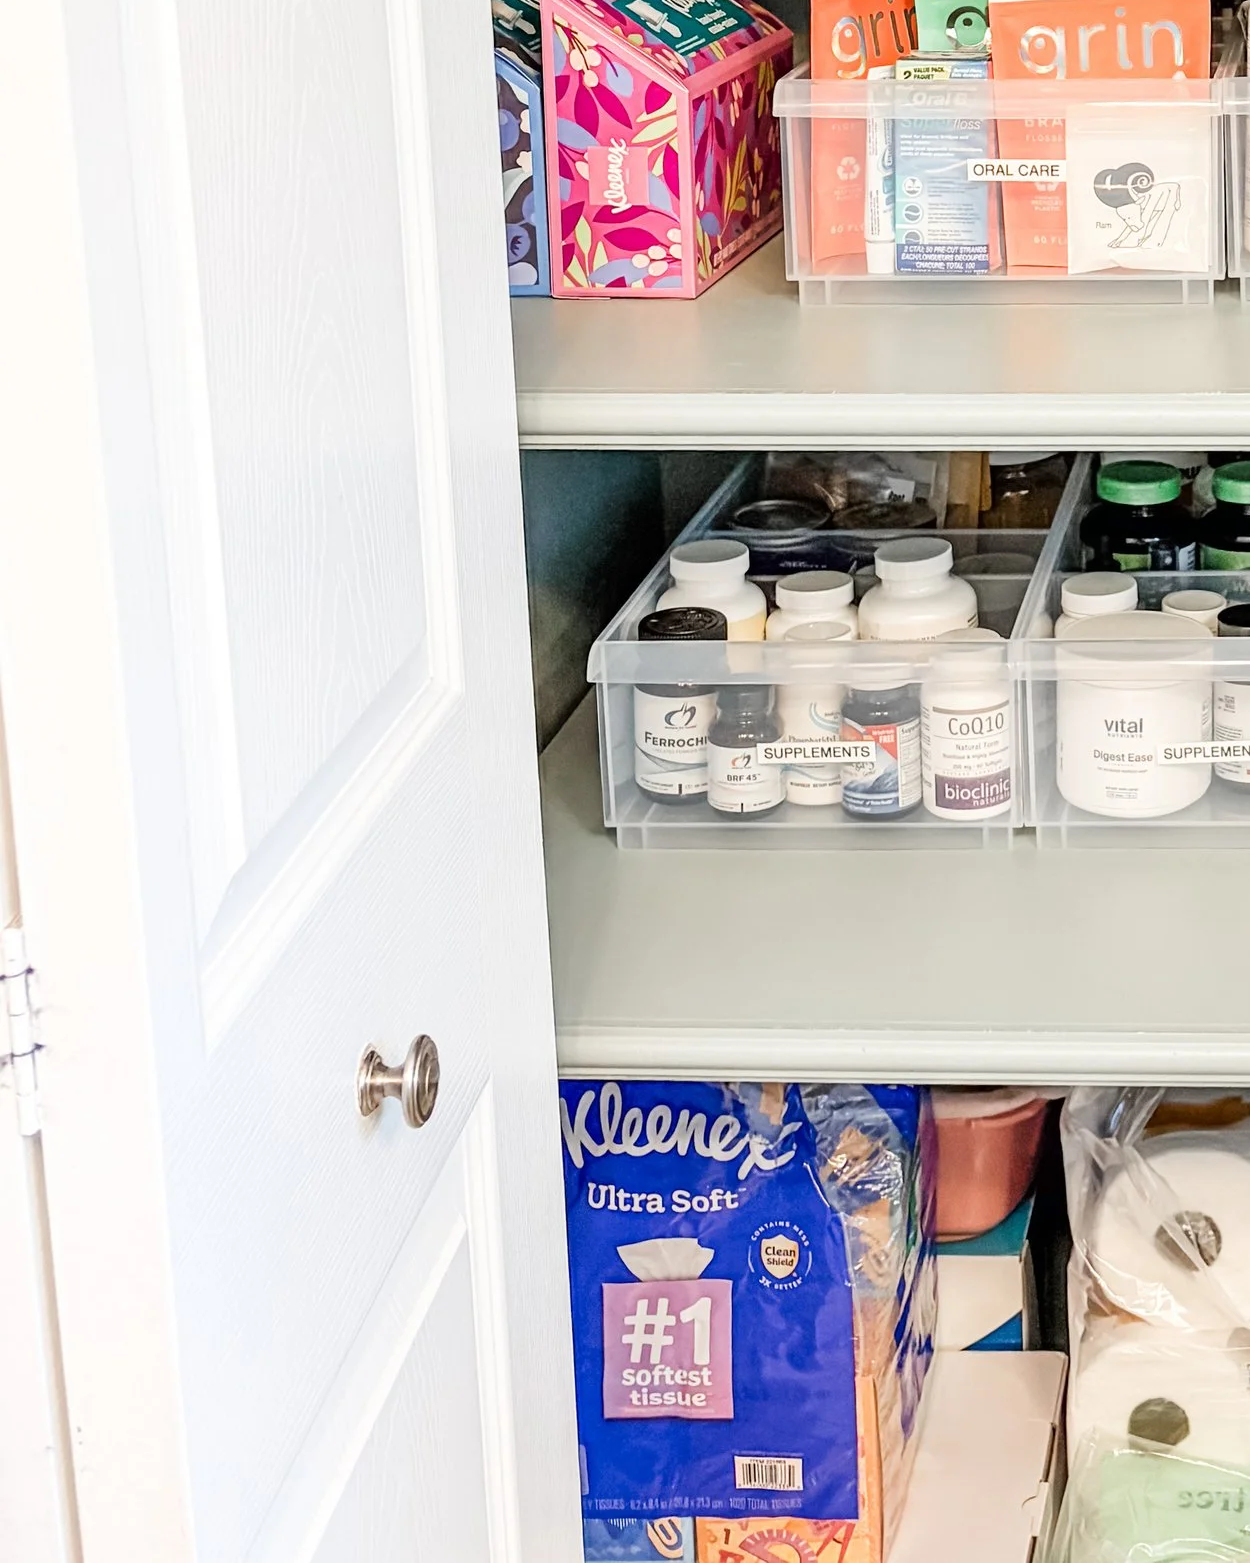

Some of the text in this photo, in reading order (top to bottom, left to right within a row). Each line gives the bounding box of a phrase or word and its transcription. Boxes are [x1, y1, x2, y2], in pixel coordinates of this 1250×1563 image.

[1018, 6, 1185, 80] grin
[603, 139, 626, 214] Kleenex
[973, 164, 1059, 176] ORAL CARE
[948, 712, 1004, 735] CoQ10
[1105, 718, 1143, 733] vital
[879, 735, 895, 743] FREE
[764, 746, 870, 758] SUPPLEMENTS
[1093, 749, 1153, 762] Digest Ease
[945, 779, 1009, 799] bioclinic
[560, 1081, 803, 1180] Kleenex
[587, 1182, 739, 1213] Ultra Soft
[751, 1221, 809, 1246] CONTAINS MESS
[765, 1246, 796, 1257] Clean
[767, 1258, 794, 1266] Shield
[759, 1276, 802, 1291] 3X BETTER
[622, 1296, 713, 1365] #1
[622, 1365, 712, 1388] softest
[630, 1389, 706, 1408] tissue
[747, 1498, 768, 1509] TOTAL
